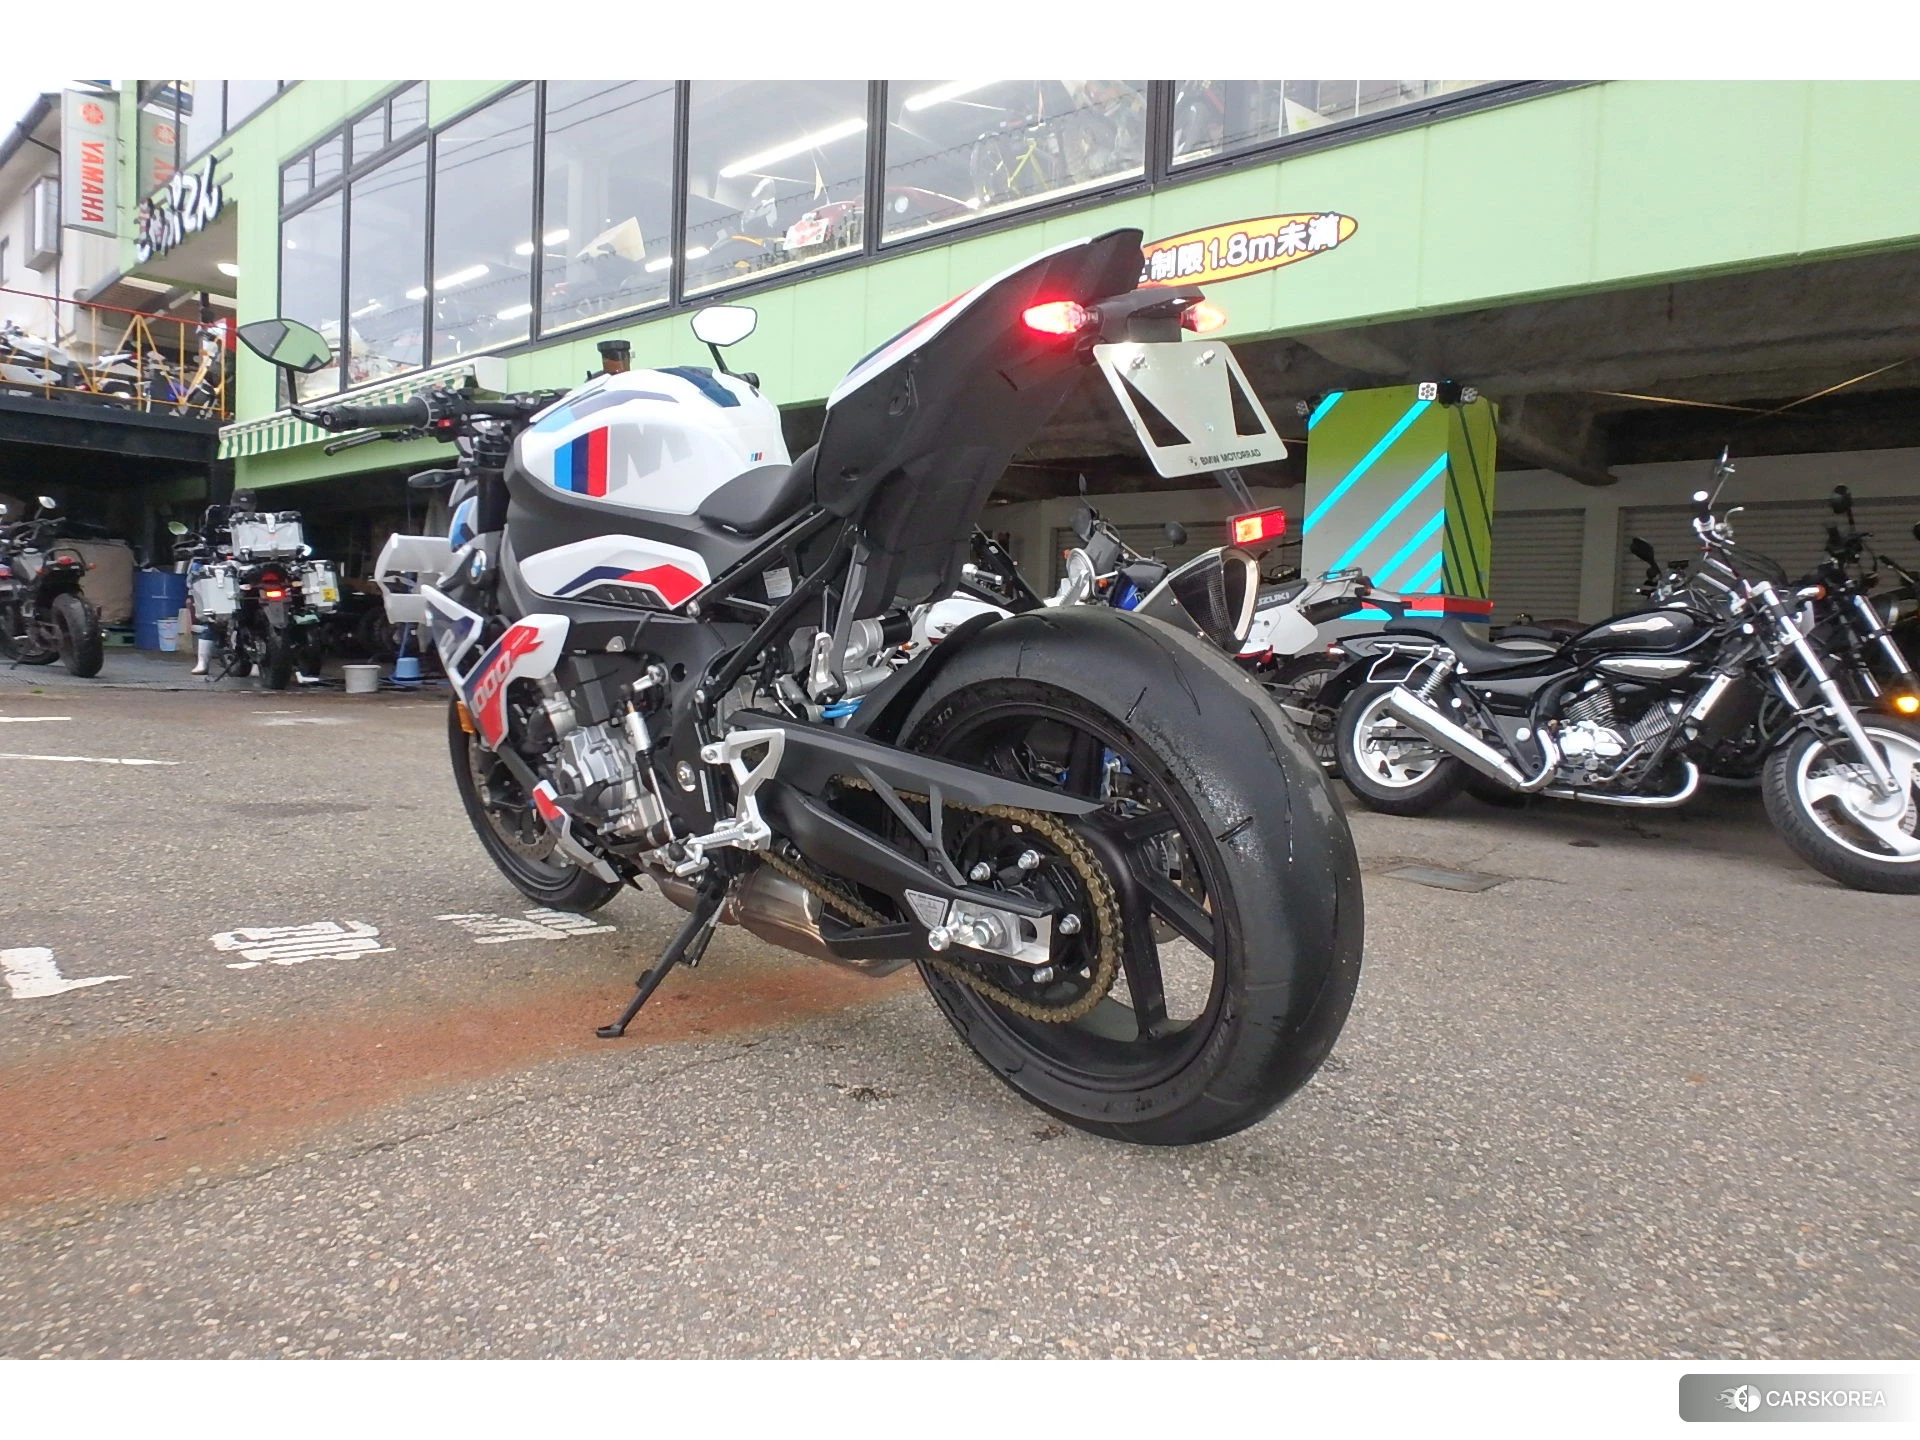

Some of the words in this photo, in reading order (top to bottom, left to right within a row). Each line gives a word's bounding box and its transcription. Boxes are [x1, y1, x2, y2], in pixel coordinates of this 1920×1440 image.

[81, 140, 105, 224] YAMAHA
[1199, 454, 1220, 466] BMW
[1220, 448, 1262, 462] MOTORRAD
